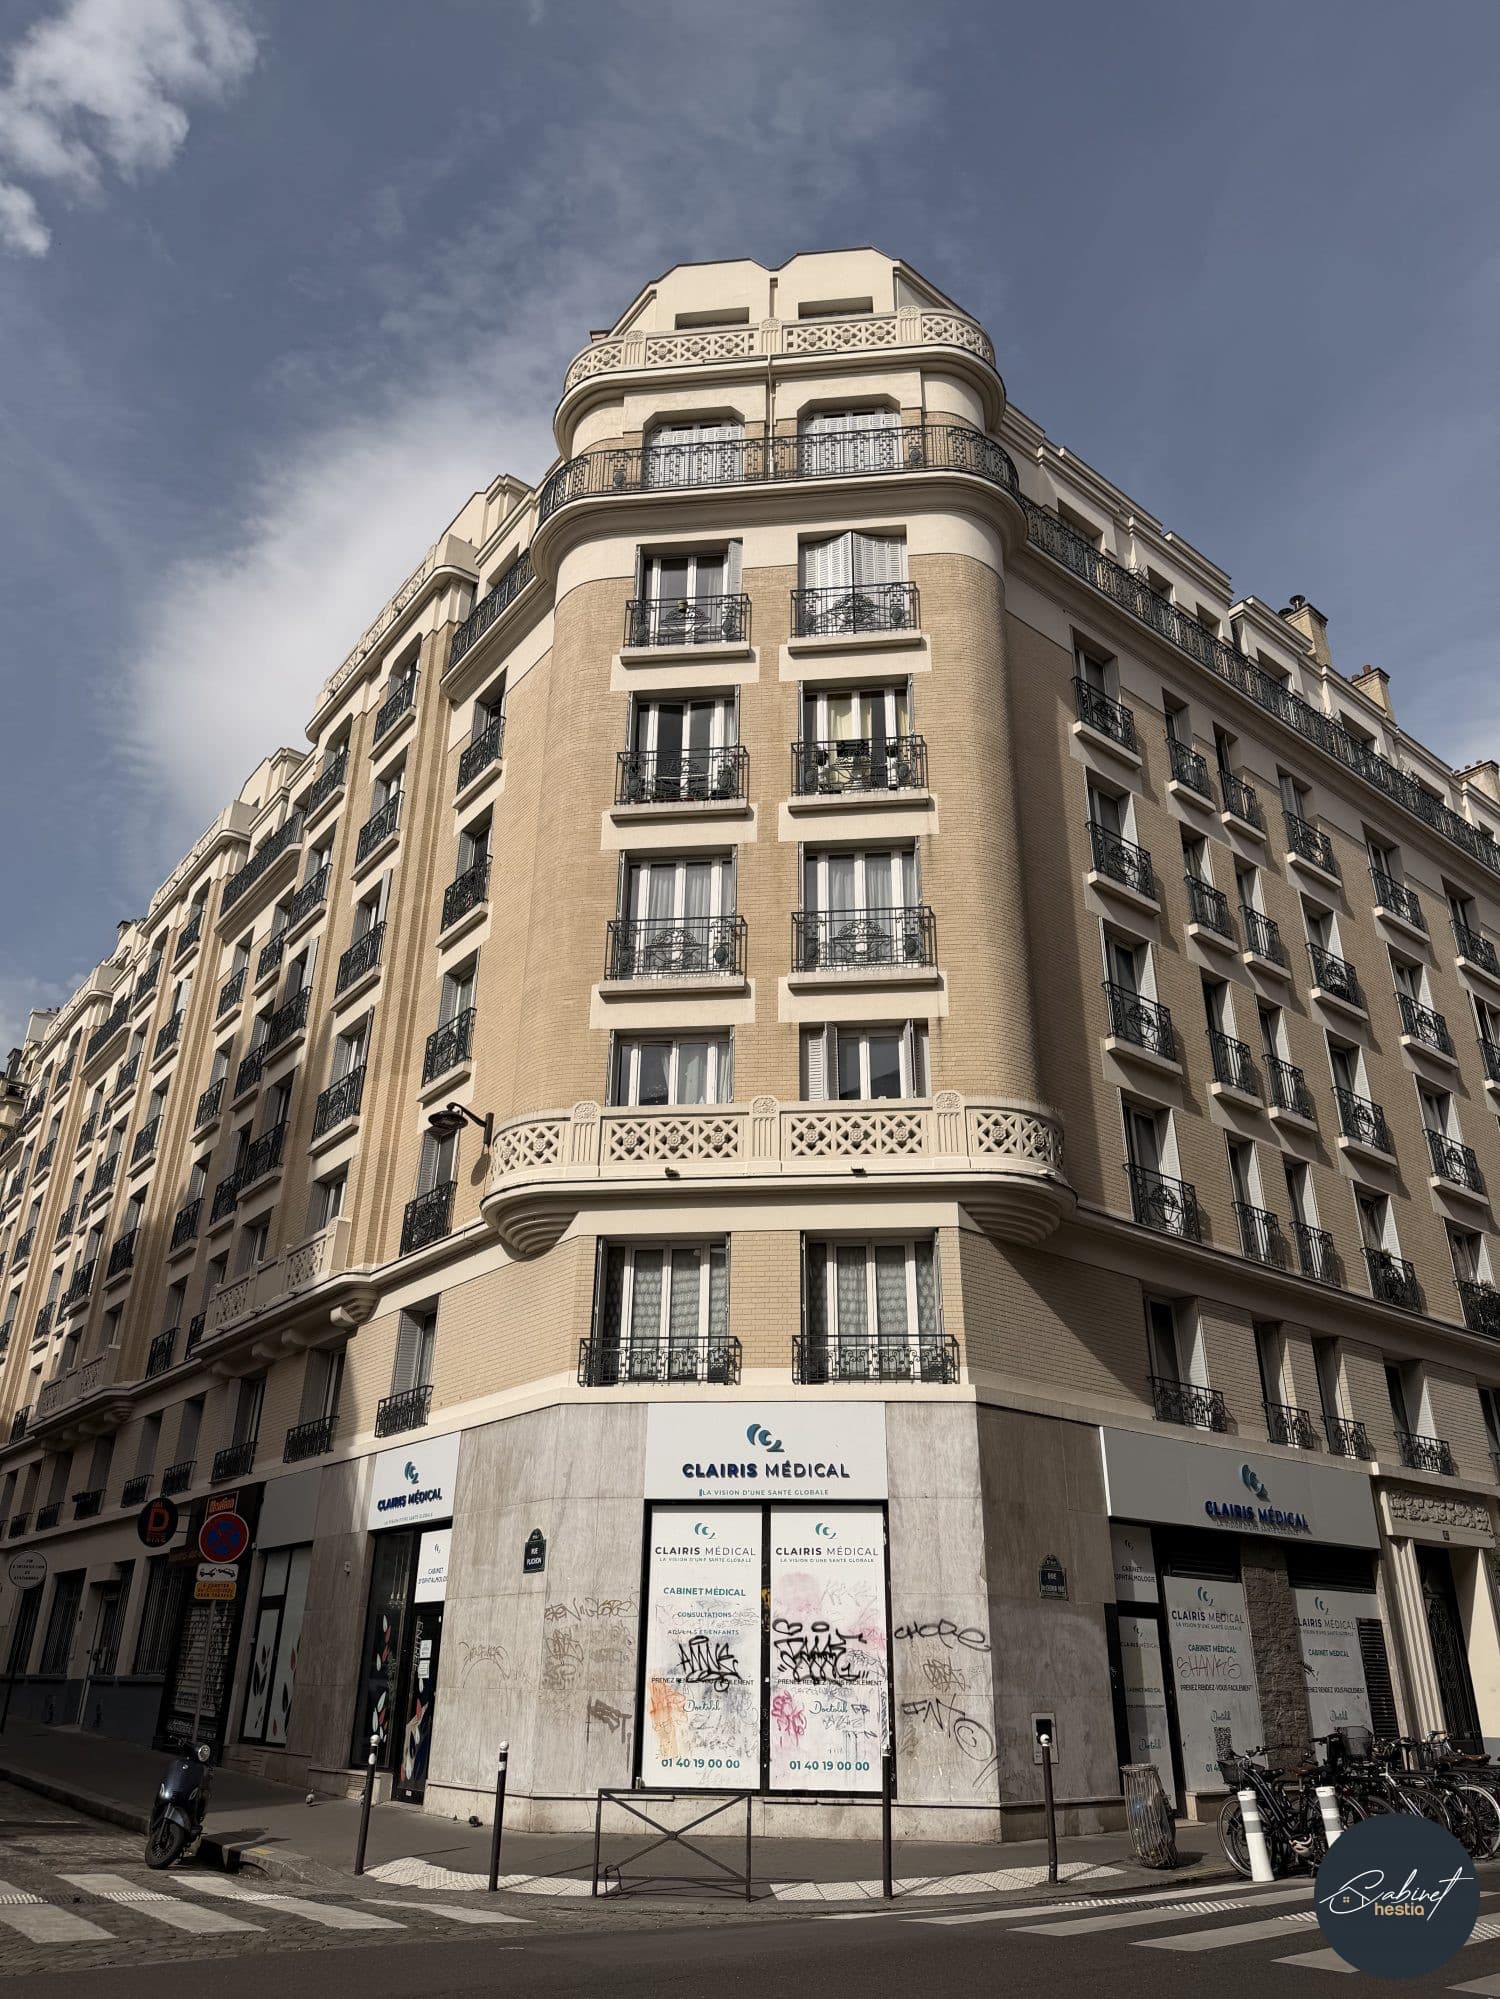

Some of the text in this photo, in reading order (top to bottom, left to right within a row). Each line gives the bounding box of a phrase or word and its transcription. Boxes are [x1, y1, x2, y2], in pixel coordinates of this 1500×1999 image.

[682, 1460, 851, 1478] CLAIRIS MÉDICAL
[377, 1488, 443, 1512] CLAIRIS MÉDICAL
[1204, 1500, 1310, 1528] CLAIRIS MÉDICAL
[655, 1545, 756, 1556] CLAIRIS MÉDICAL
[775, 1546, 879, 1556] CLAIRIS MÉDICAL
[663, 1586, 746, 1596] CABINET MÉDICAL
[1171, 1610, 1206, 1621] CLAIRIS
[1187, 1644, 1212, 1652] CABINET
[1308, 1648, 1329, 1657] CABINET
[661, 1759, 740, 1769] 01 40 19 00 00
[789, 1761, 870, 1771] 01 40 19 00 00
[1205, 1763, 1213, 1773] 01
